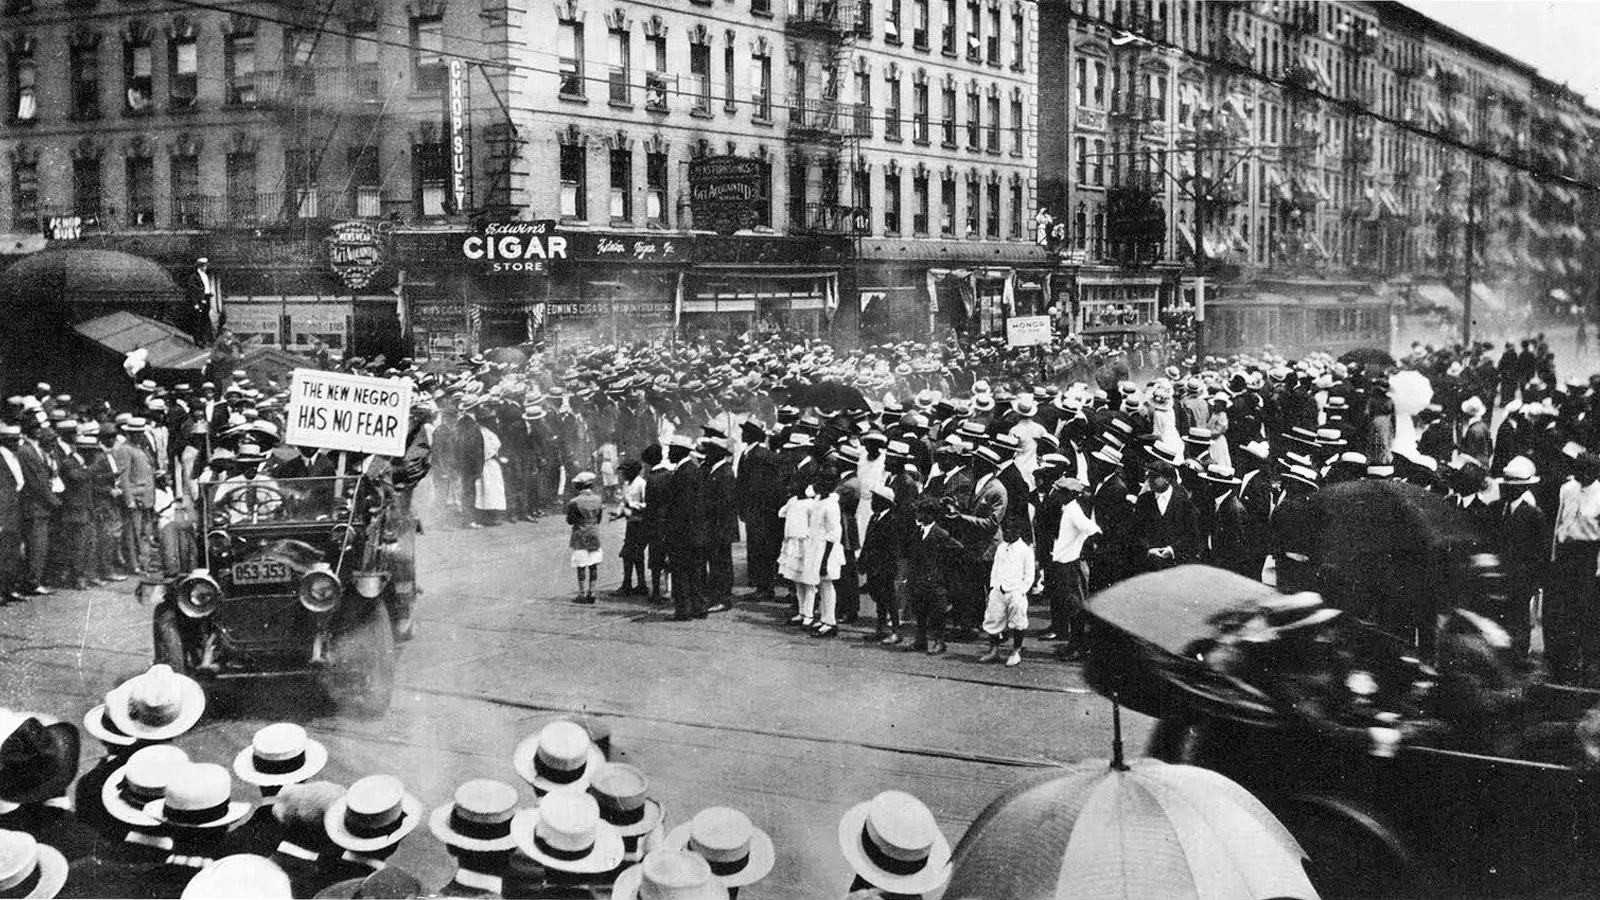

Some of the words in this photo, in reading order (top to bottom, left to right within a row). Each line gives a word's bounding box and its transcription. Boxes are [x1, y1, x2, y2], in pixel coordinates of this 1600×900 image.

[451, 60, 463, 134] CHOP
[453, 136, 465, 210] SUEY
[484, 222, 546, 236] Edwin's
[463, 236, 567, 260] CIGAR
[493, 262, 544, 271] STORE
[303, 381, 324, 399] THE
[327, 384, 350, 402] NEW
[353, 387, 400, 407] NEGRO
[298, 405, 327, 431] HAS
[332, 409, 353, 433] NO
[356, 411, 398, 439] FEAR
